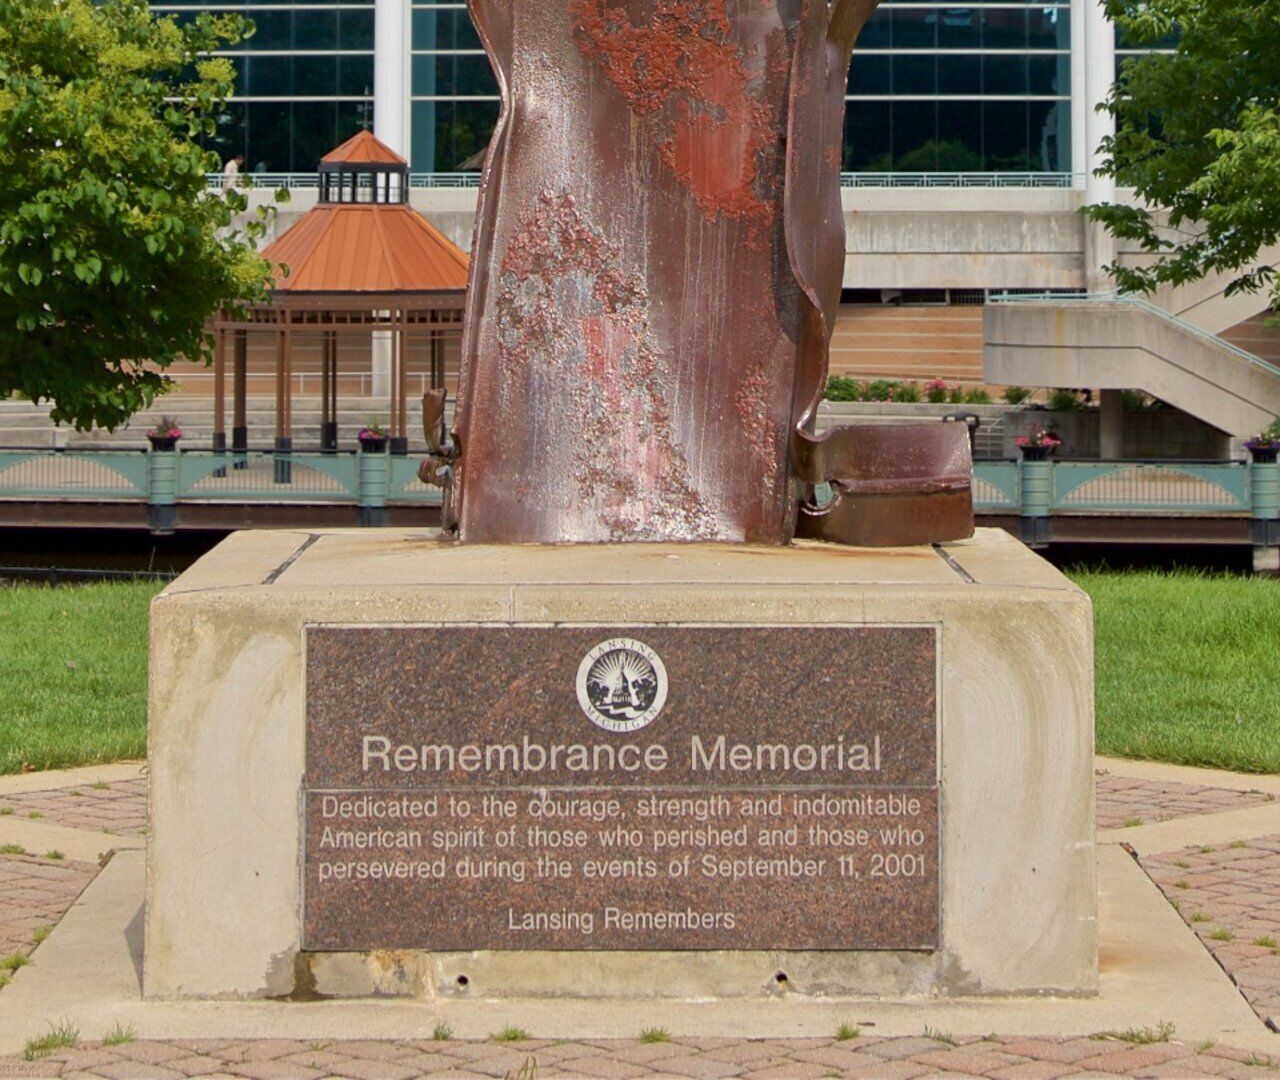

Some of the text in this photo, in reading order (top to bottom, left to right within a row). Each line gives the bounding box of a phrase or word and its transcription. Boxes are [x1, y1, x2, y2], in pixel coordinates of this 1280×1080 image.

[589, 639, 657, 660] LANSING
[586, 706, 658, 730] MICHIGAN
[362, 735, 881, 771] Remembrance Memorial
[322, 794, 921, 821] Dedicated to the courage, strength and indomitable
[320, 825, 925, 852] American spirit of those who perished and those who
[320, 854, 926, 882] persevered during the events of September 11, 2001
[508, 907, 736, 934] Lansing Remembers
